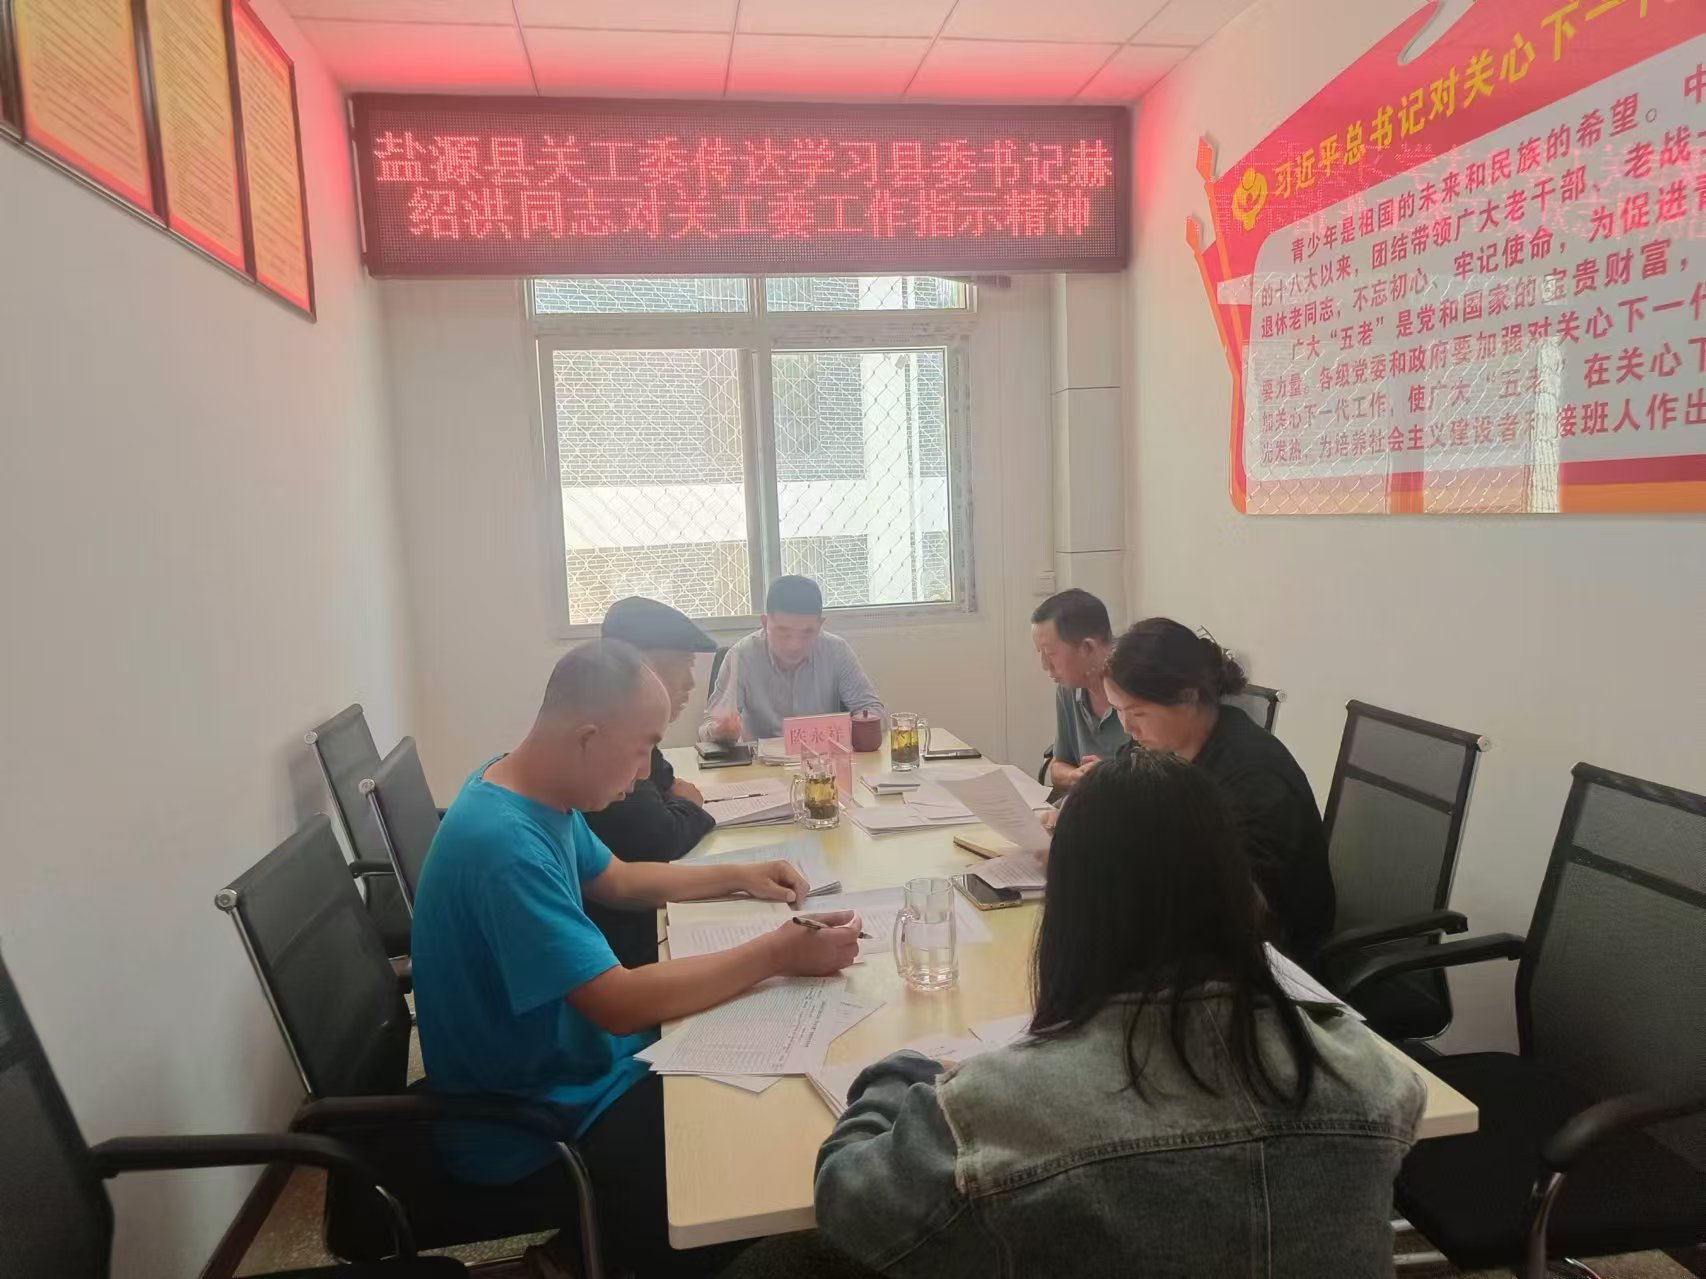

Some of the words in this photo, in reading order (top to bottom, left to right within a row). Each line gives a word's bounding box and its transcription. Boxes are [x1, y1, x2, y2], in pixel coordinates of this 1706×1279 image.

[1274, 0, 1648, 199] 习近平总书记对关心下一
[374, 131, 1112, 188] 盐源县关工委传达学习县委书记赫
[408, 187, 1092, 239] 绍洪同志对关工委工作指示精神
